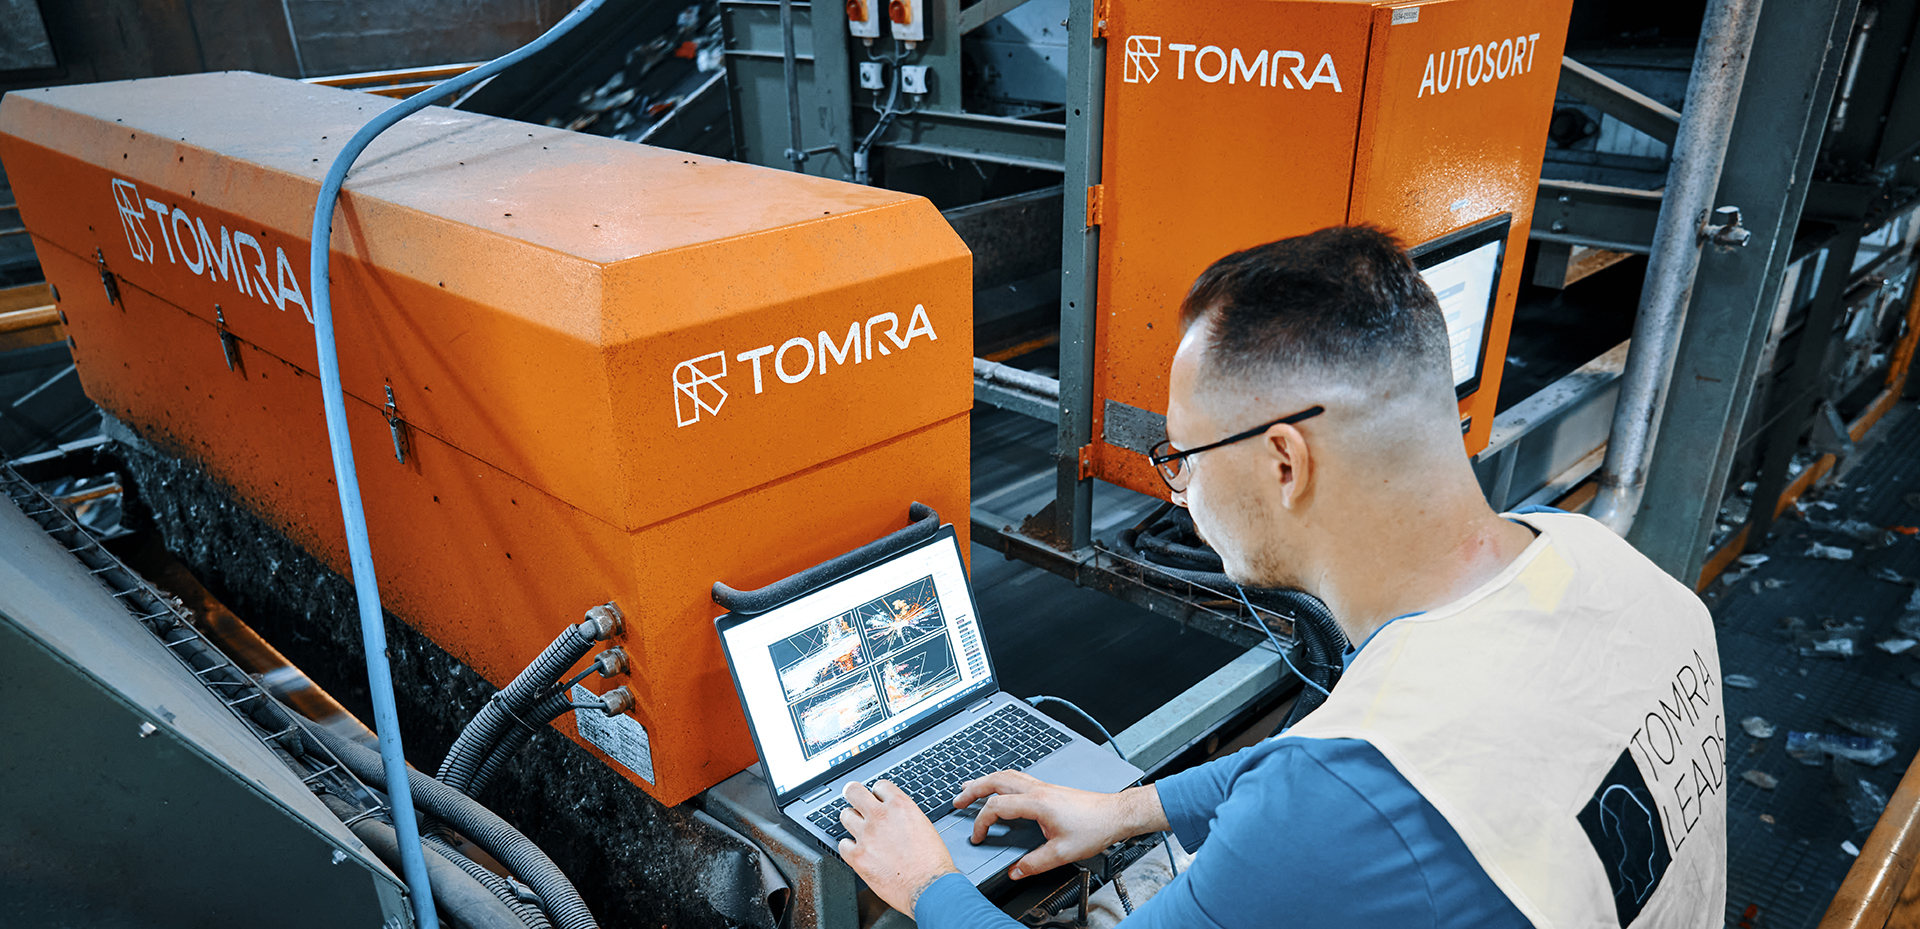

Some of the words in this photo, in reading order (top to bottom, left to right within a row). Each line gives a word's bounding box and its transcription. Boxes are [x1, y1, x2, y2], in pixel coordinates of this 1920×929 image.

[1169, 42, 1342, 92] TOMRA
[1418, 33, 1539, 97] AUTOSORT
[146, 198, 313, 323] TOMRA
[737, 303, 937, 393] TOMRA
[888, 735, 902, 745] DELL
[1630, 649, 1714, 782] TOMRA
[1662, 714, 1727, 852] LEADS
